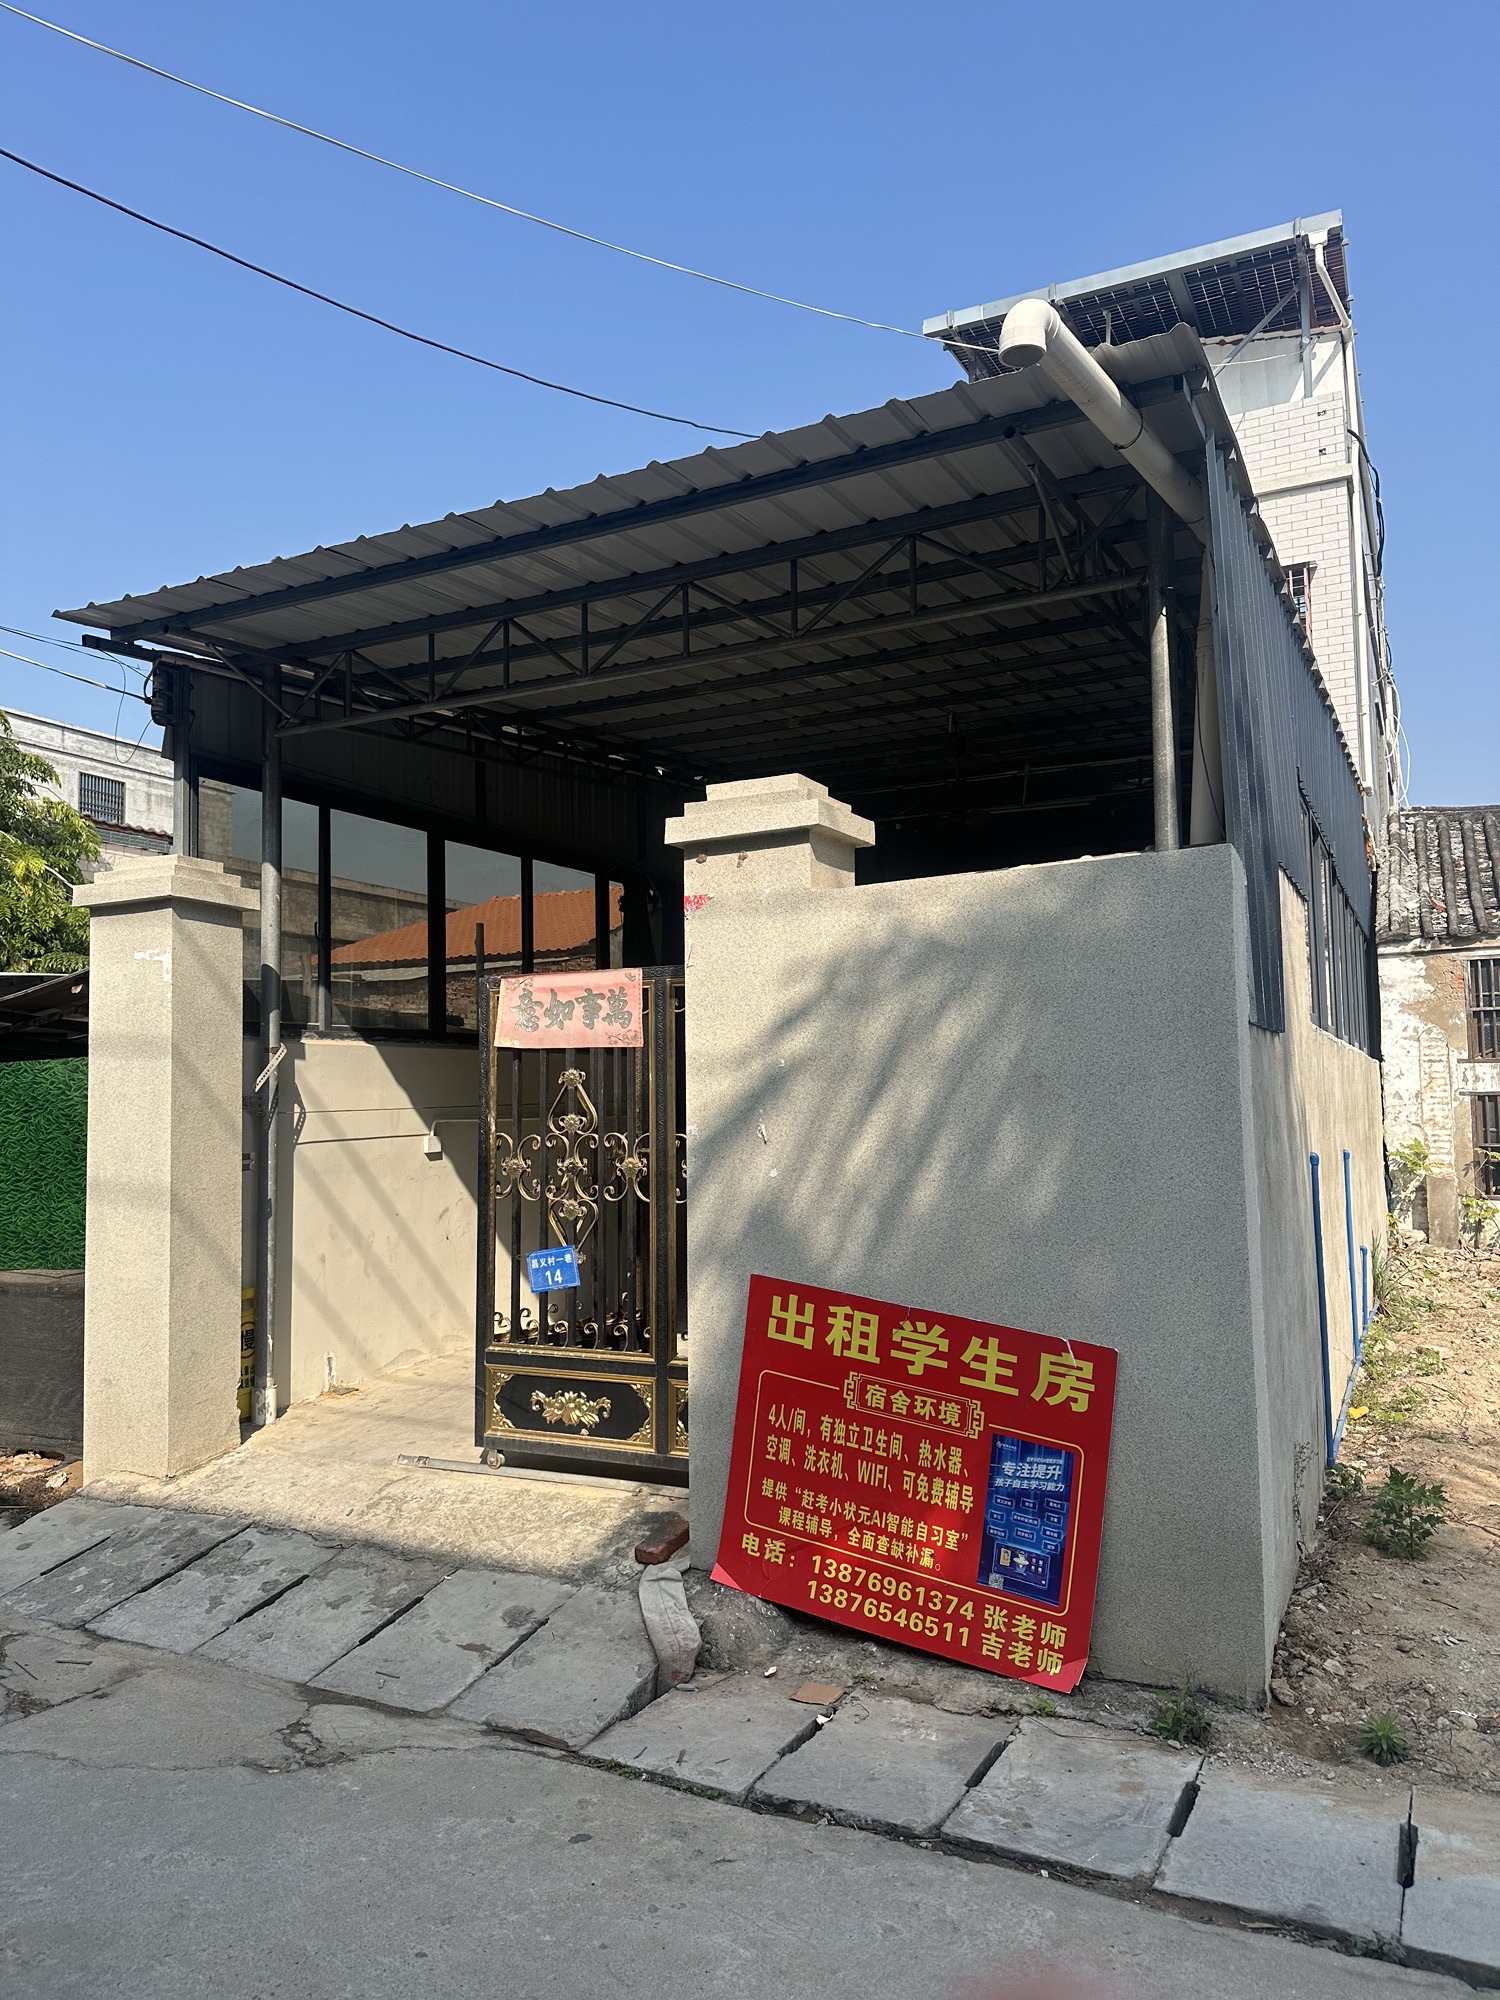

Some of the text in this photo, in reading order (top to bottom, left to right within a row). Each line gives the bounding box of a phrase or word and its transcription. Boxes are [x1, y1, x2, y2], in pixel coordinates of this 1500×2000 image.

[545, 1269, 563, 1285] 14
[241, 1329, 255, 1351] 慢
[767, 1294, 1095, 1412] 出租学生房
[865, 1384, 961, 1428] 宿舍环境
[994, 1478, 1065, 1492] 孩子自主学习能力
[1002, 1462, 1061, 1480] 专注提升
[741, 1532, 1067, 1650] 电话： 13876961374 张老师
[807, 1580, 1064, 1676] 13876546511 吉老师
